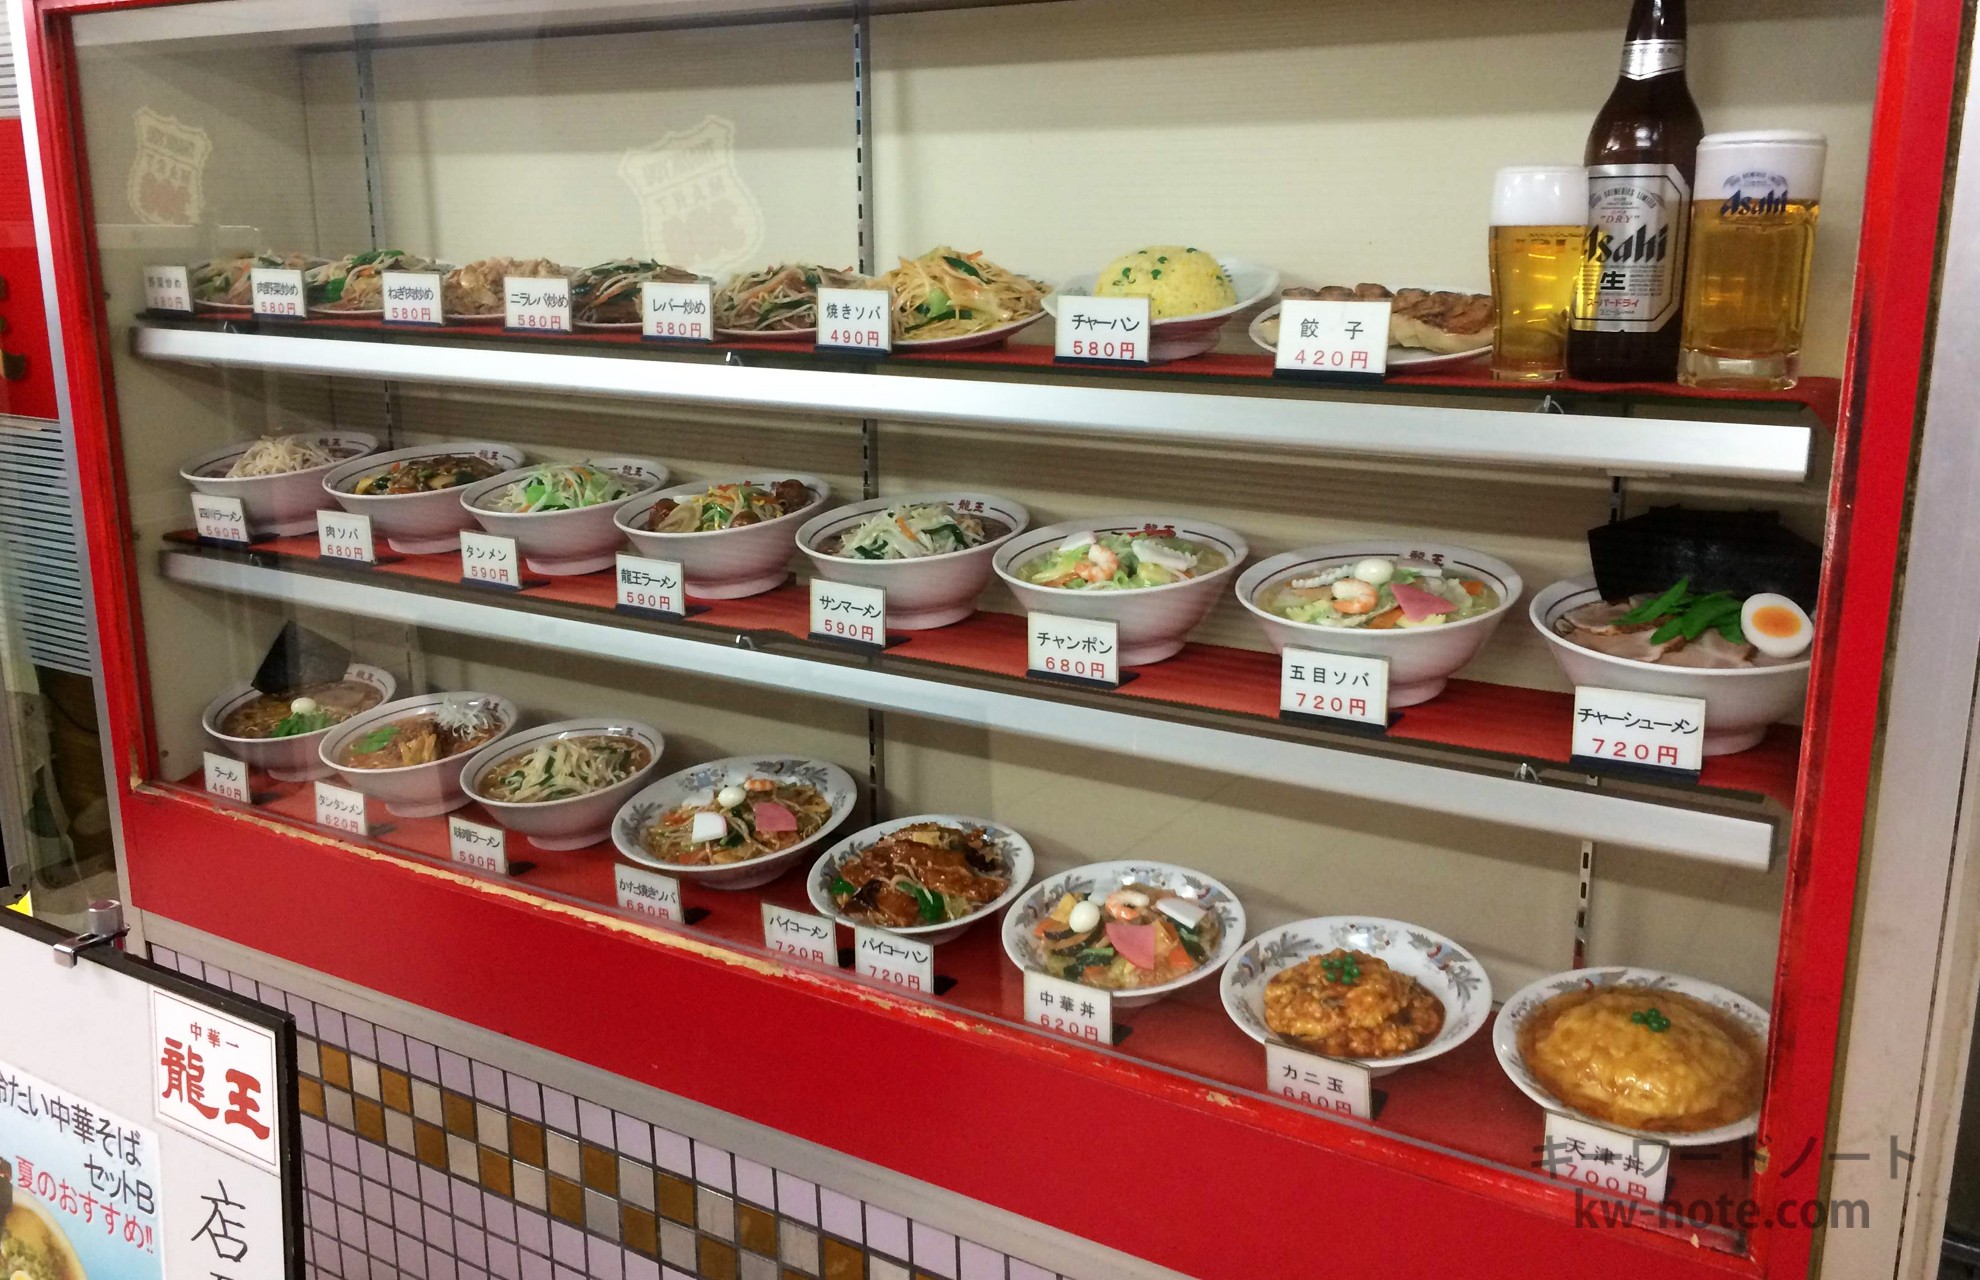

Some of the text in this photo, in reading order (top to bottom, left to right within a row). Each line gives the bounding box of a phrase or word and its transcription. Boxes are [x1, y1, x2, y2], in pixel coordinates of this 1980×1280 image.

[1719, 189, 1788, 216] Asahi
[1583, 223, 1669, 263] Asahi
[256, 281, 299, 296] 肉野菜炒め
[1600, 270, 1626, 291] 生
[387, 286, 434, 302] ねぎ肉炒め
[510, 292, 569, 309] ニラレバ炒め
[261, 302, 296, 316] 580円
[391, 308, 431, 321] 580円
[652, 298, 706, 316] レバー炒め
[825, 302, 881, 320] 焼きソバ
[517, 314, 562, 330] 580円
[655, 321, 702, 337] 580円
[1071, 313, 1140, 332] チャーハン
[830, 329, 880, 347] 490円
[1073, 340, 1136, 360] 580円
[1294, 349, 1370, 370] 420円
[205, 525, 241, 540] 590円
[325, 525, 360, 541] 肉ソバ
[327, 544, 363, 560] 680円
[466, 544, 507, 562] タンメン
[470, 566, 509, 582] 590円
[620, 567, 677, 589] 龍王ラーメン
[626, 590, 671, 610] 590円
[819, 595, 882, 619] サンマーメン
[824, 618, 874, 642] 590円
[1036, 630, 1113, 655] チャンポン
[1045, 656, 1105, 679] 680円
[1289, 663, 1371, 688] 五目ソバ
[1295, 692, 1367, 717] 720円
[1577, 706, 1700, 736] チャーシューメン
[1592, 737, 1679, 767] 720円
[214, 766, 238, 783] ラーメン
[211, 782, 242, 800] 490円
[318, 793, 364, 816] タンタンメン
[453, 825, 502, 849] 味噌ラーメン
[459, 850, 498, 872] 590円
[769, 915, 829, 940] パイコーメン
[775, 940, 825, 963] 720円
[862, 938, 928, 963] パイコーハン
[868, 965, 921, 991] 720円
[1040, 990, 1096, 1019] 中華丼
[1040, 1014, 1099, 1041] 620円
[160, 1036, 270, 1140] 龍王
[1282, 1063, 1345, 1095] カニ玉
[1564, 1136, 1645, 1175] 天津丼
[84, 1154, 155, 1215] セットB
[1565, 1163, 1649, 1201] 700円
[191, 1179, 248, 1280] 店
